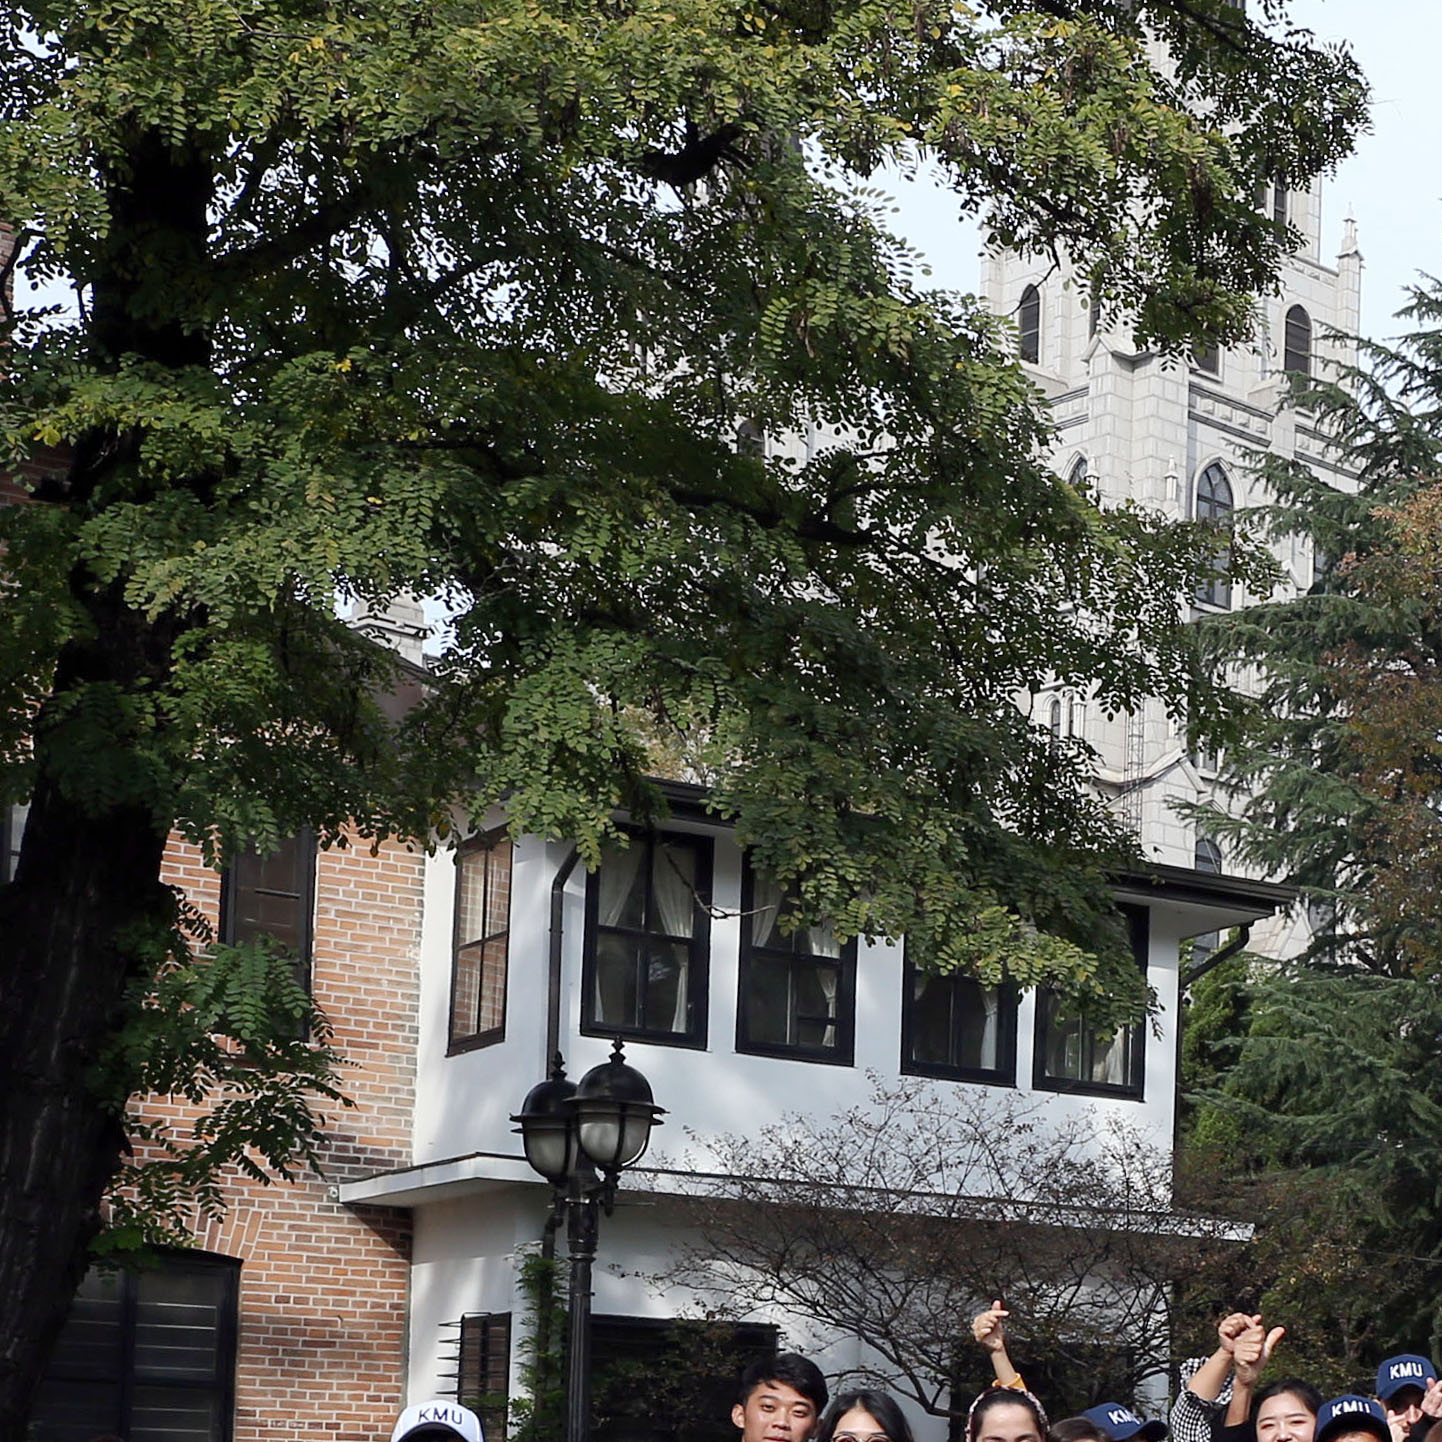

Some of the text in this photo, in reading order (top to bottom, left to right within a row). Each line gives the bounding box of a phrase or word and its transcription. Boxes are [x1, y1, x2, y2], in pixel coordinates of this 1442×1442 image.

[1390, 1363, 1423, 1379] KMU
[418, 1408, 463, 1425] KMU
[1108, 1408, 1140, 1425] KM
[1332, 1404, 1370, 1417] KMU
